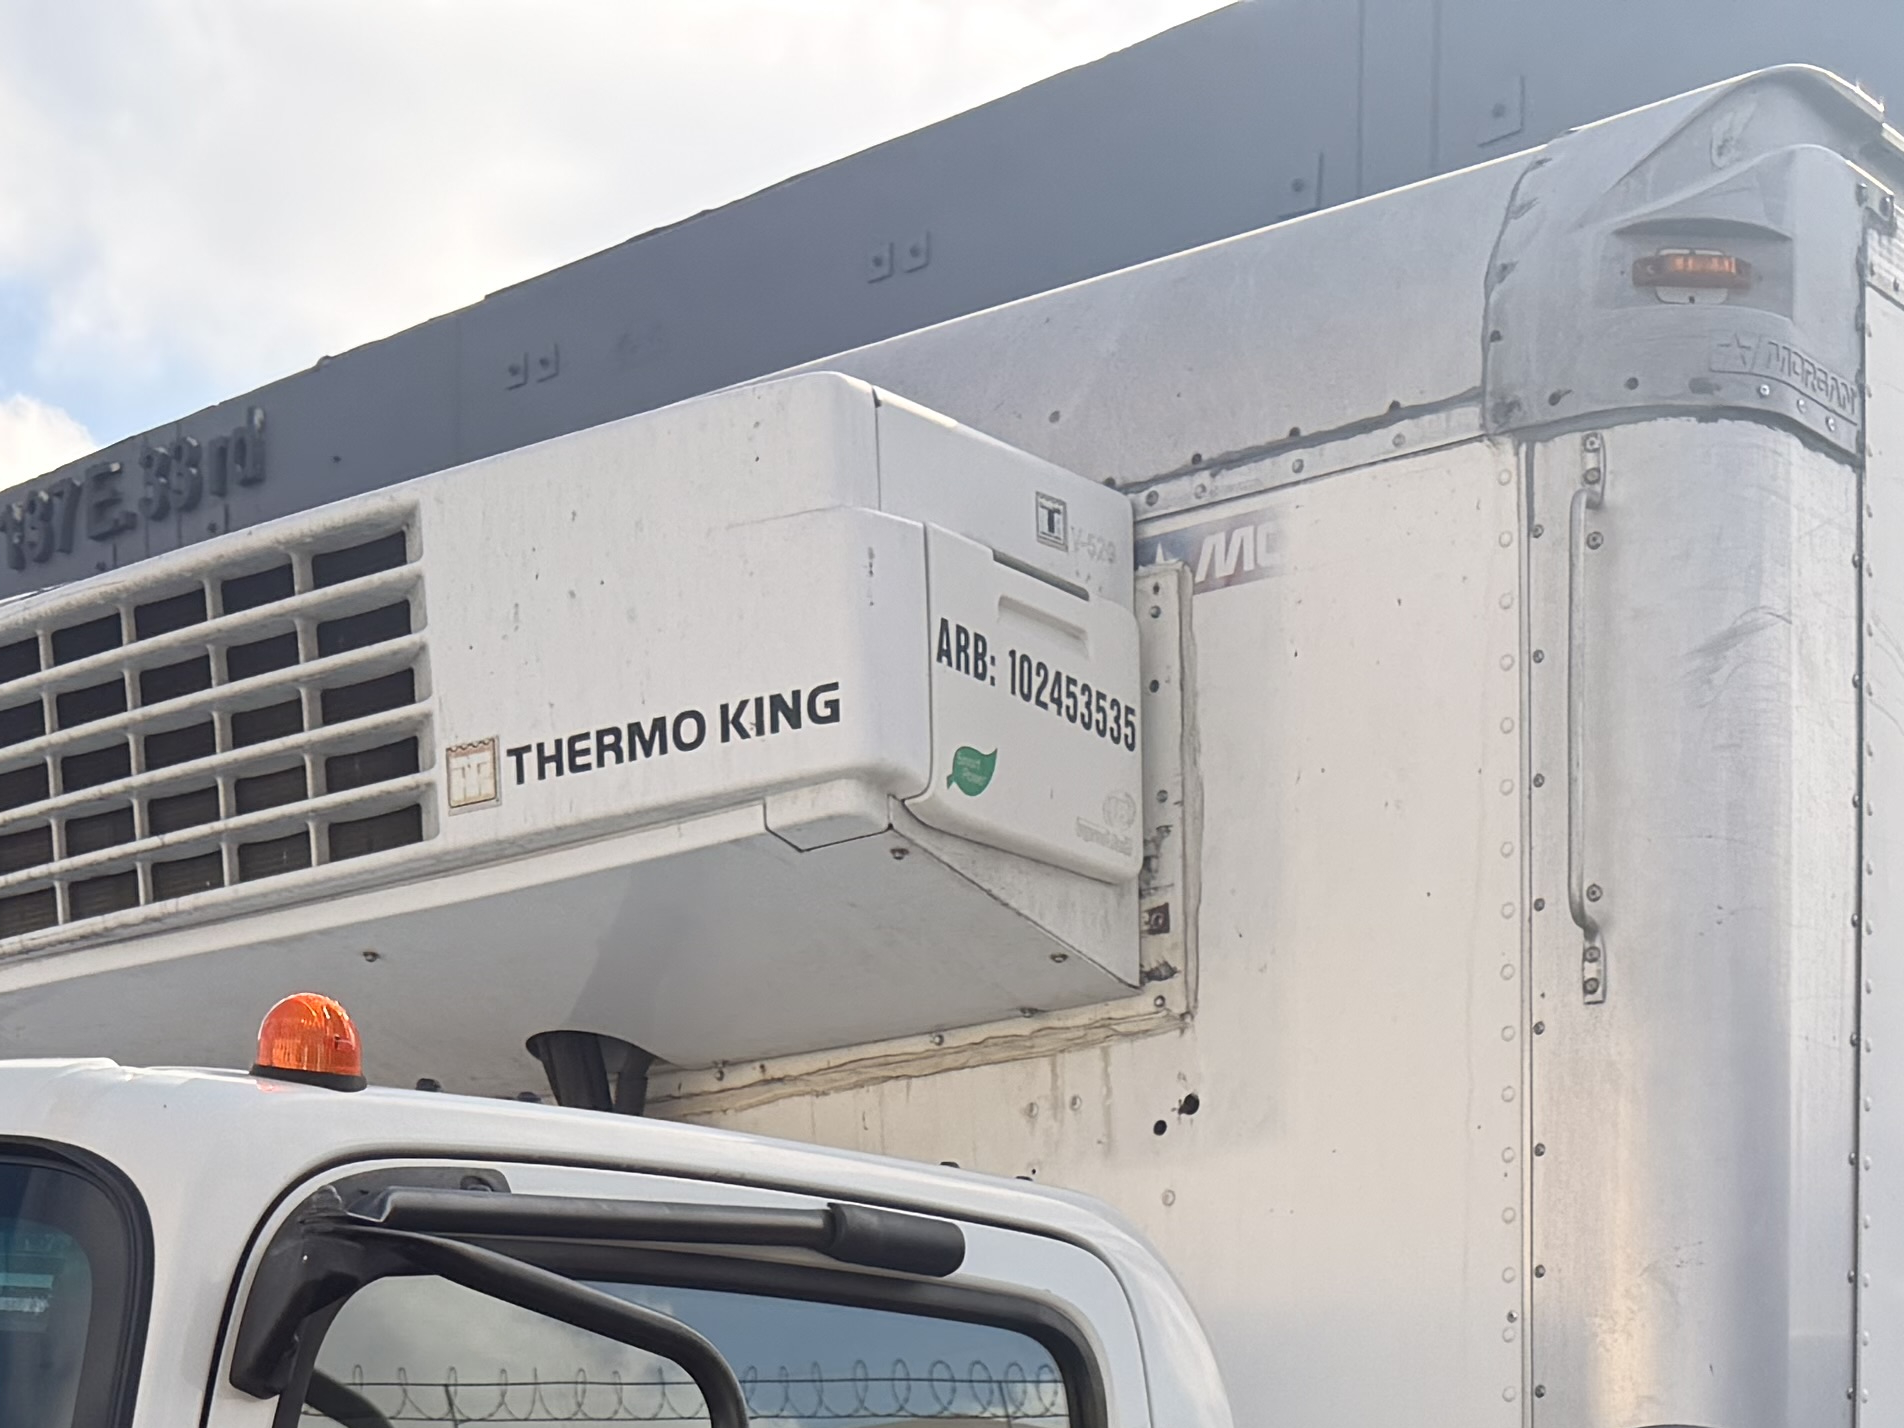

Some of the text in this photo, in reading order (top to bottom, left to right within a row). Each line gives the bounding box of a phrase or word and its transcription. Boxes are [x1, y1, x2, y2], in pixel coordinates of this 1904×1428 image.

[506, 681, 841, 786] THERMO KING
[936, 617, 1137, 752] ARB: 102453535
